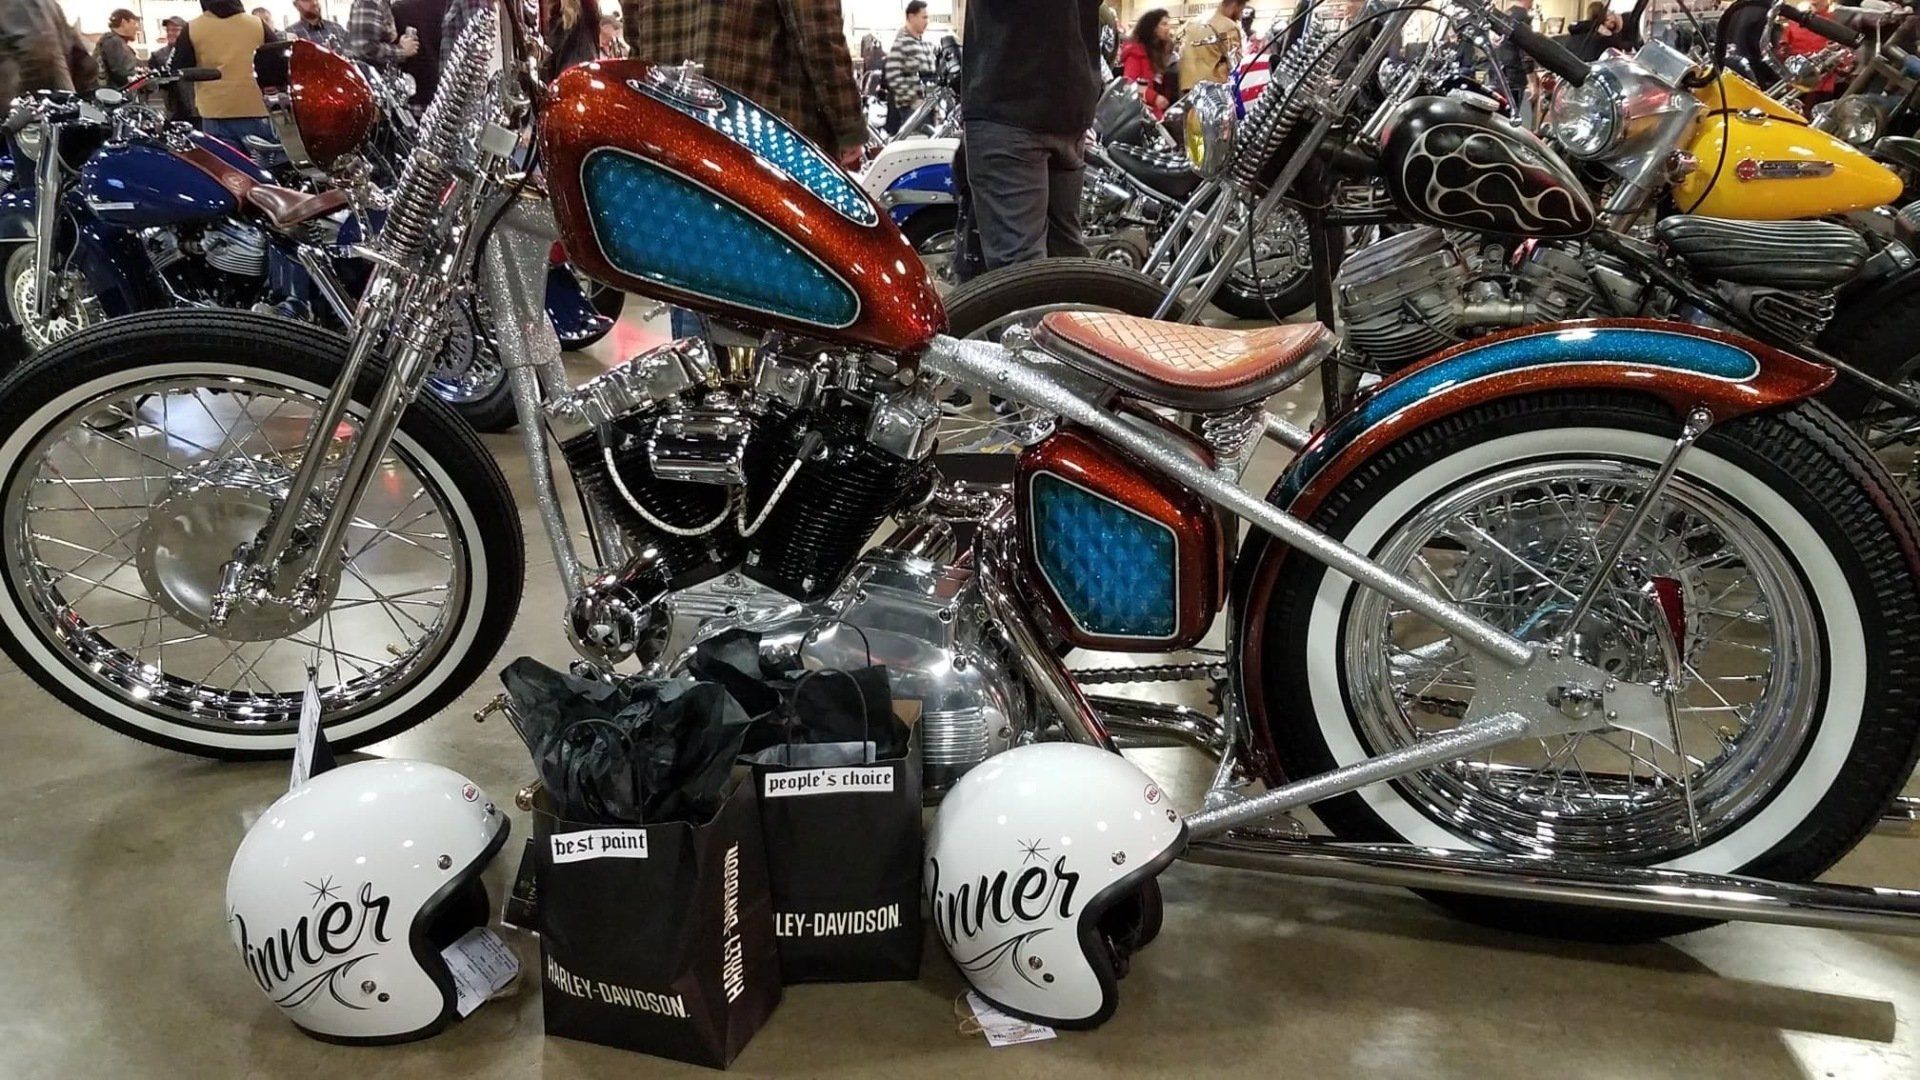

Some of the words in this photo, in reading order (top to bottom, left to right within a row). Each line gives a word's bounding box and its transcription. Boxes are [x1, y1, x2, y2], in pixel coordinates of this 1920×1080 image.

[768, 770, 837, 793] people's
[842, 770, 892, 786] choice
[554, 834, 594, 856] best
[601, 831, 645, 852] paint
